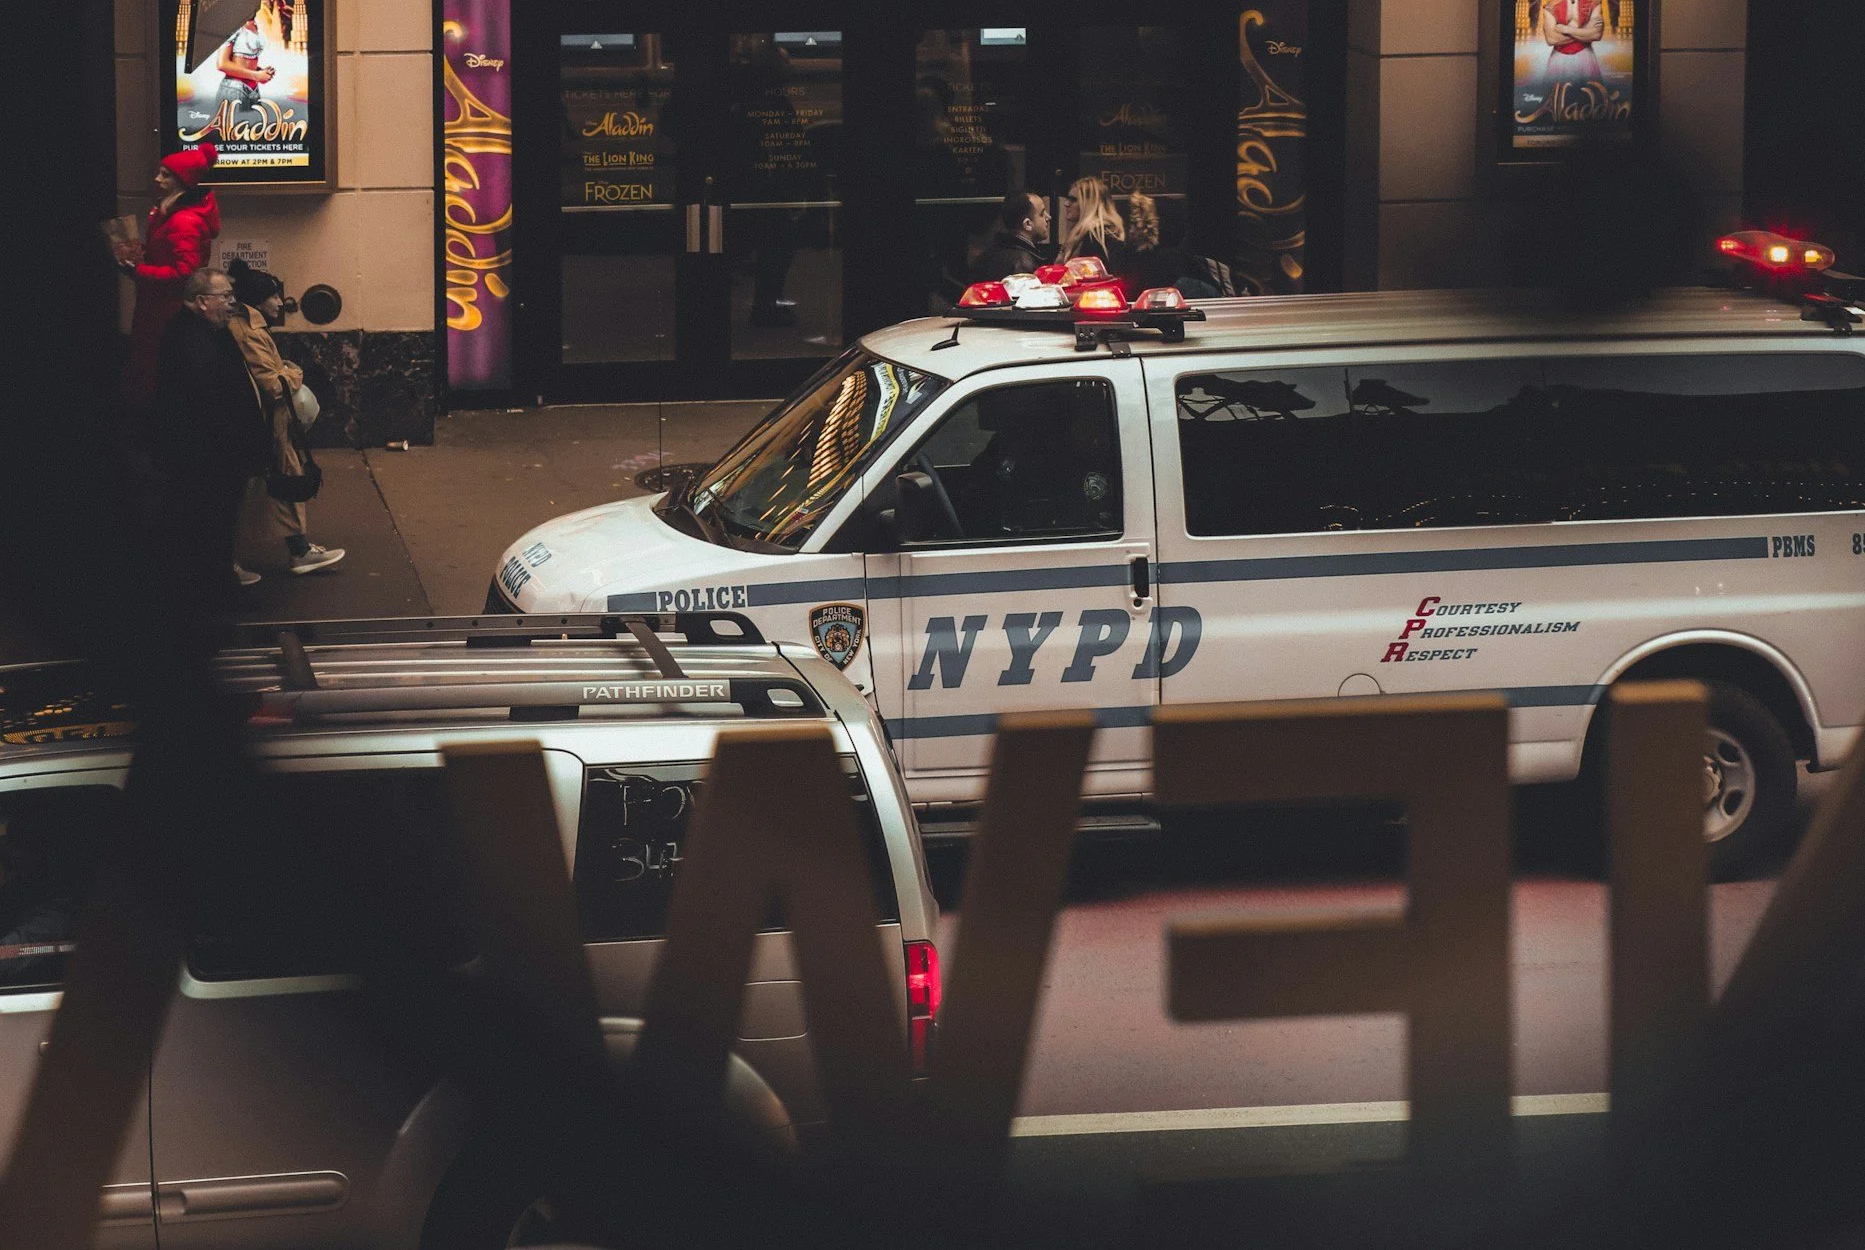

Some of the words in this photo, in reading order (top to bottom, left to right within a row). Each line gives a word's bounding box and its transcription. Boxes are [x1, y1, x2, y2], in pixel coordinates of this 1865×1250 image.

[178, 98, 308, 142] Aladdin
[582, 111, 655, 138] Aladdin
[225, 143, 248, 152] YOUR
[249, 143, 281, 152] TICKETS
[282, 142, 303, 151] HERE
[582, 152, 601, 165] THE
[602, 151, 627, 167] LION
[629, 151, 655, 166] KING
[1101, 169, 1166, 192] FROZEN
[584, 180, 654, 204] FROZEN
[236, 242, 252, 251] FIRE
[1771, 533, 1816, 558] PBMS
[1852, 532, 1865, 555] 8
[658, 584, 746, 612] POLICE
[1415, 595, 1523, 617] COURTESY
[812, 613, 862, 628] DEPARTMENT
[822, 606, 852, 616] POLICE
[1397, 618, 1582, 640] PROFESSIONALISM
[814, 635, 826, 652] CITY
[906, 605, 1204, 691] NYPD
[1380, 641, 1479, 663] RESPECT
[842, 649, 855, 665] NEW
[582, 684, 726, 700] PATHFINDER
